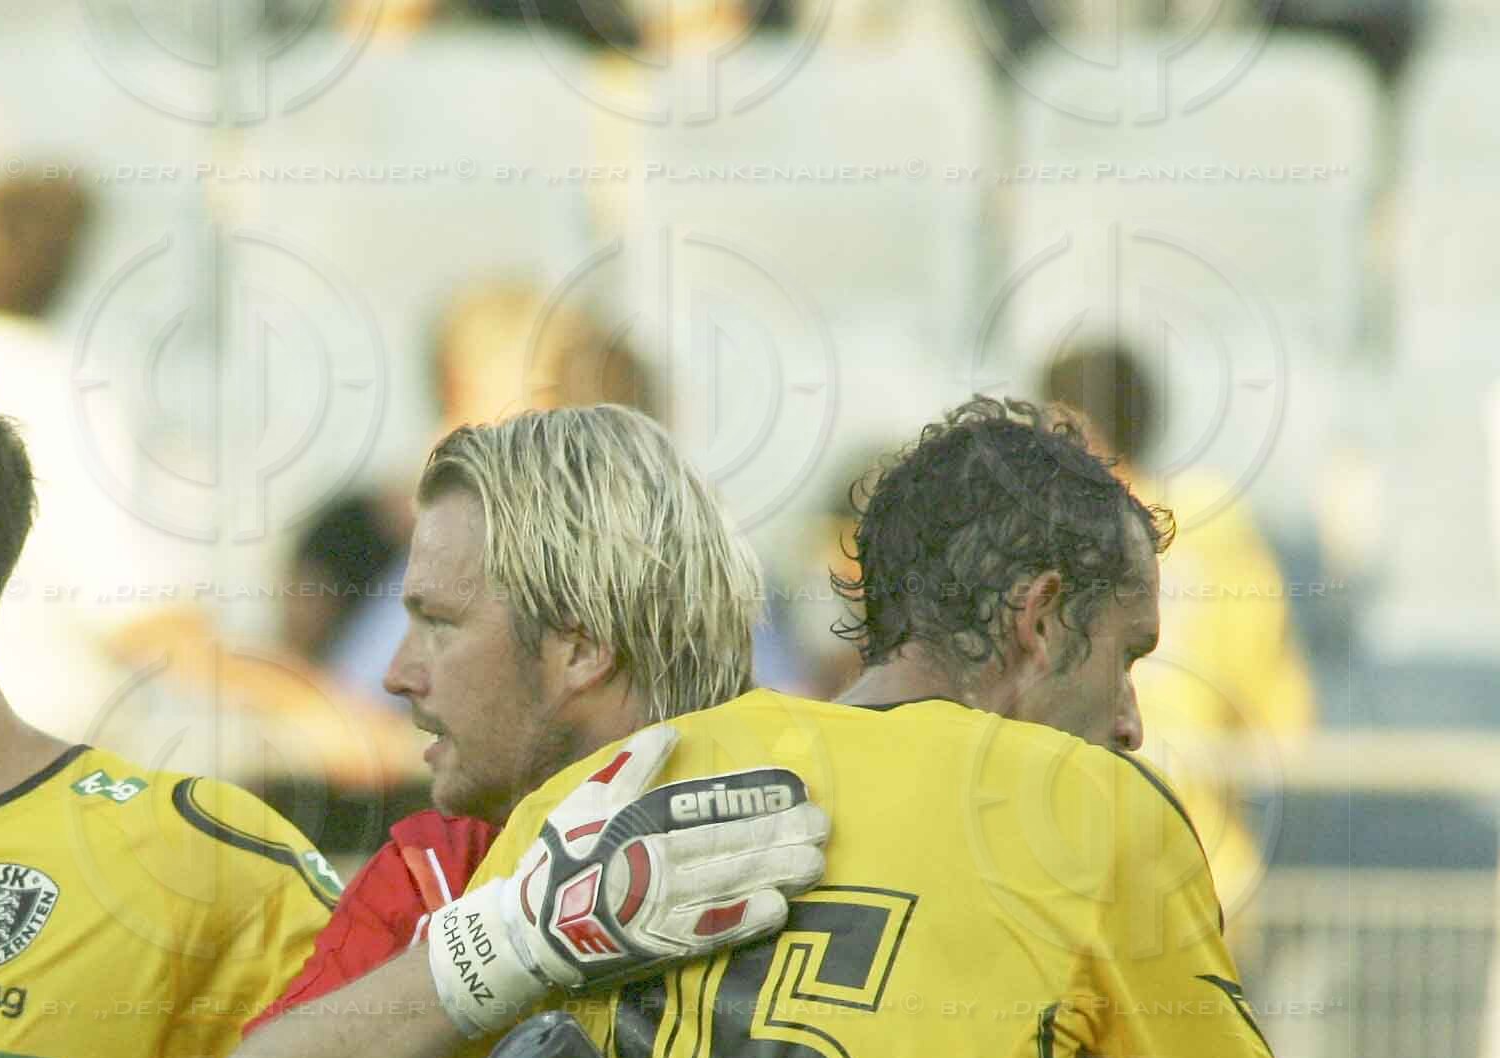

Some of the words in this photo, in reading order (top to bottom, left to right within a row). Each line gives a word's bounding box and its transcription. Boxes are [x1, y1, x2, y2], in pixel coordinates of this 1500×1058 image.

[671, 783, 792, 822] erima
[0, 866, 30, 888] SK
[465, 912, 497, 966] ANDI
